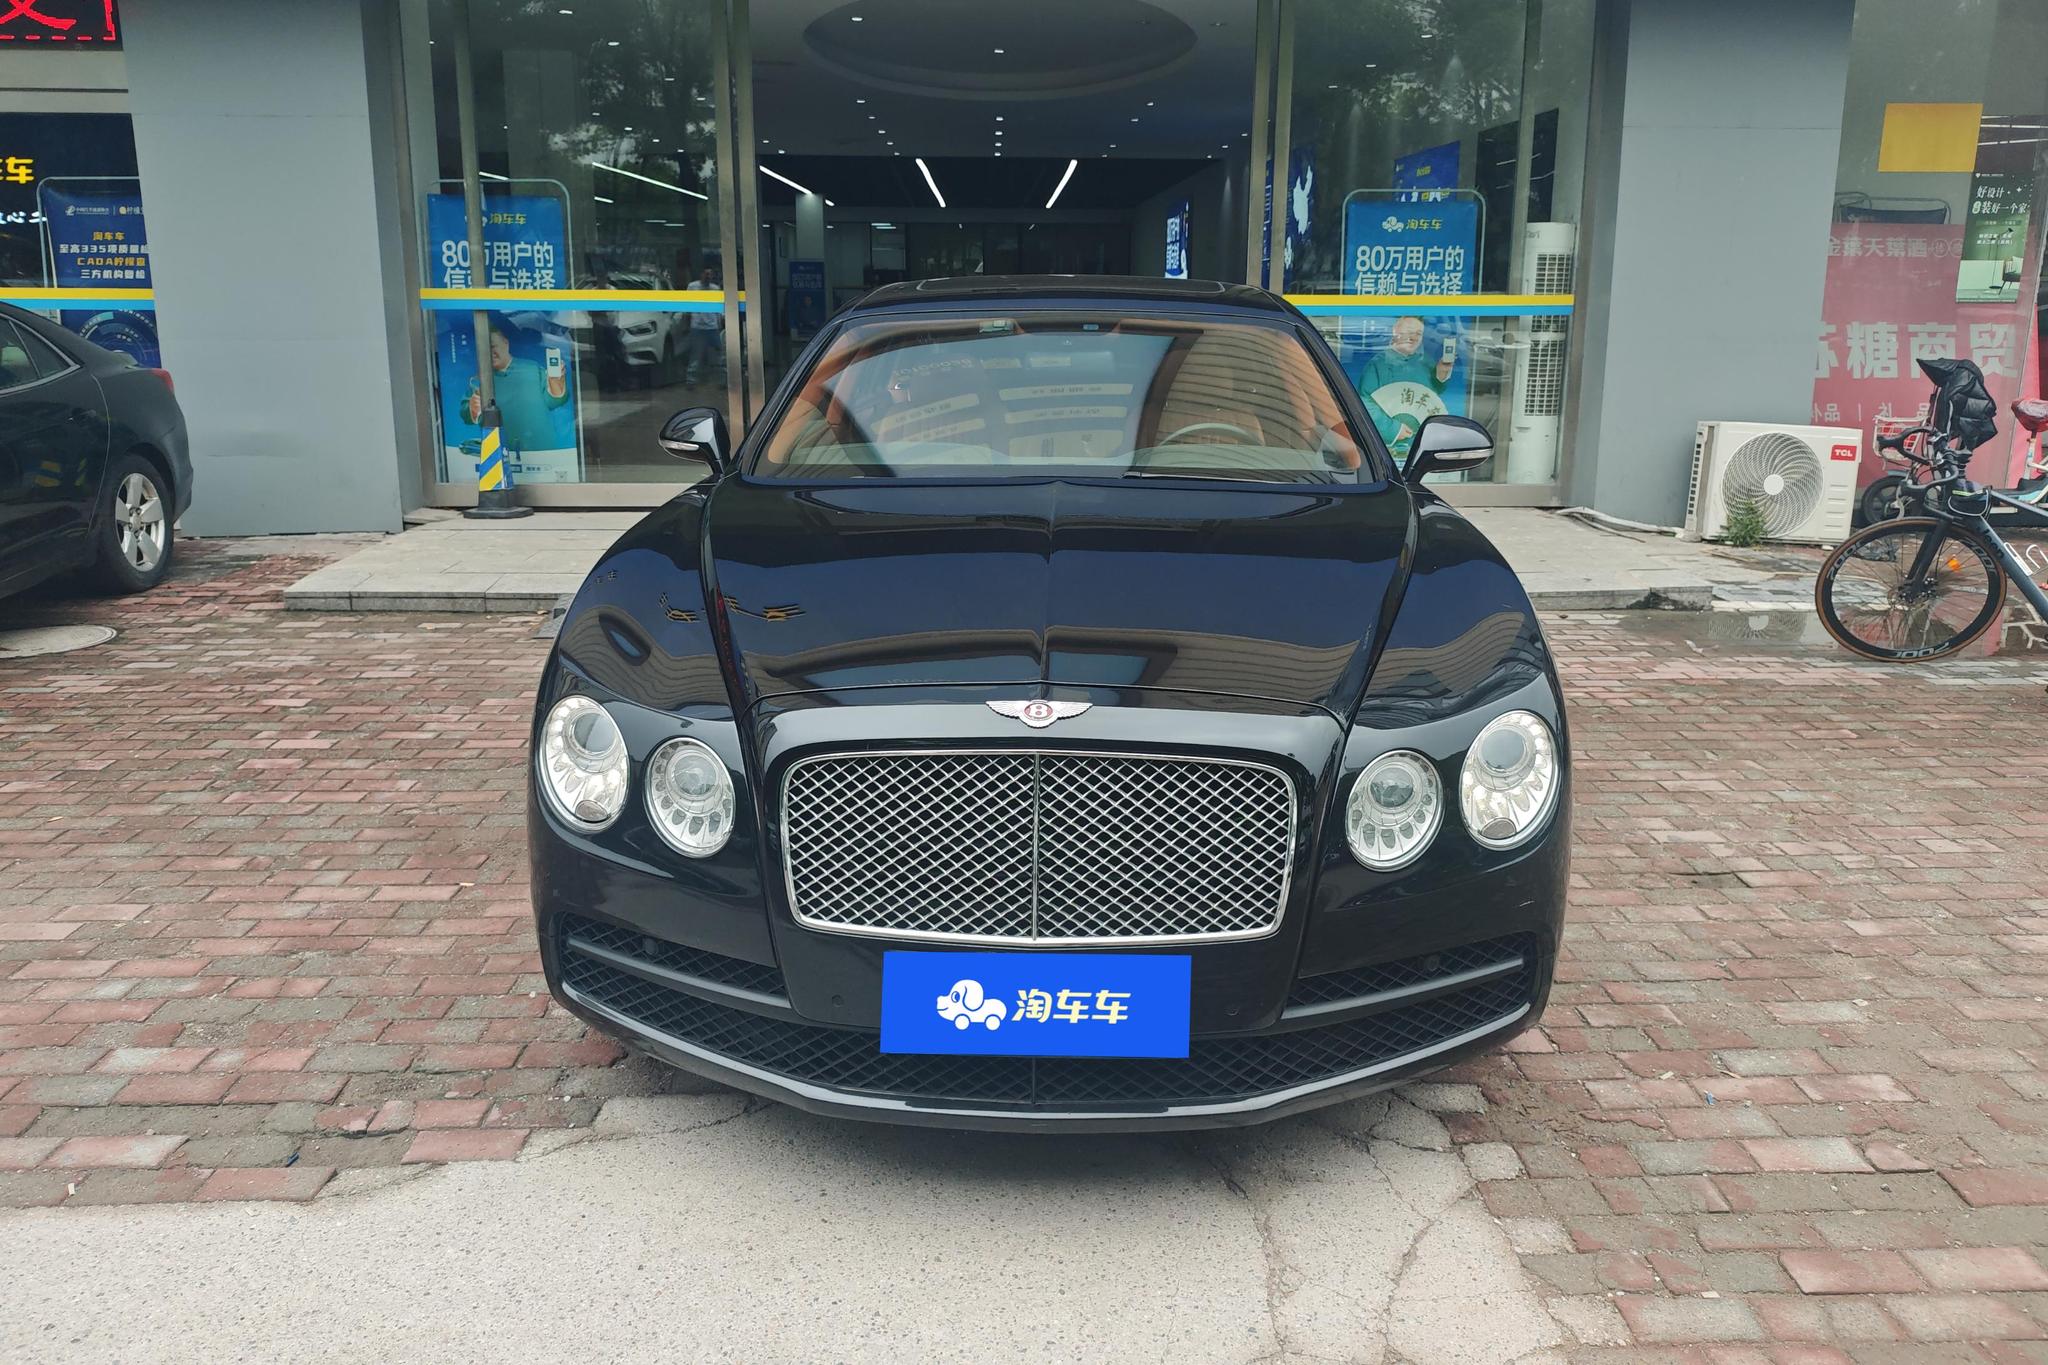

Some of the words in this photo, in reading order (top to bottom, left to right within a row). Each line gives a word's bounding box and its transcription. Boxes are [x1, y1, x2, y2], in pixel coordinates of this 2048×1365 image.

[0, 156, 34, 184] 车
[489, 213, 527, 225] 淘车车
[1406, 218, 1443, 230] 淘车车
[1356, 244, 1465, 272] 80万用户的
[443, 267, 556, 290] 信与选择
[1355, 271, 1463, 296] 信赖与选择
[1835, 449, 1853, 458] TCL
